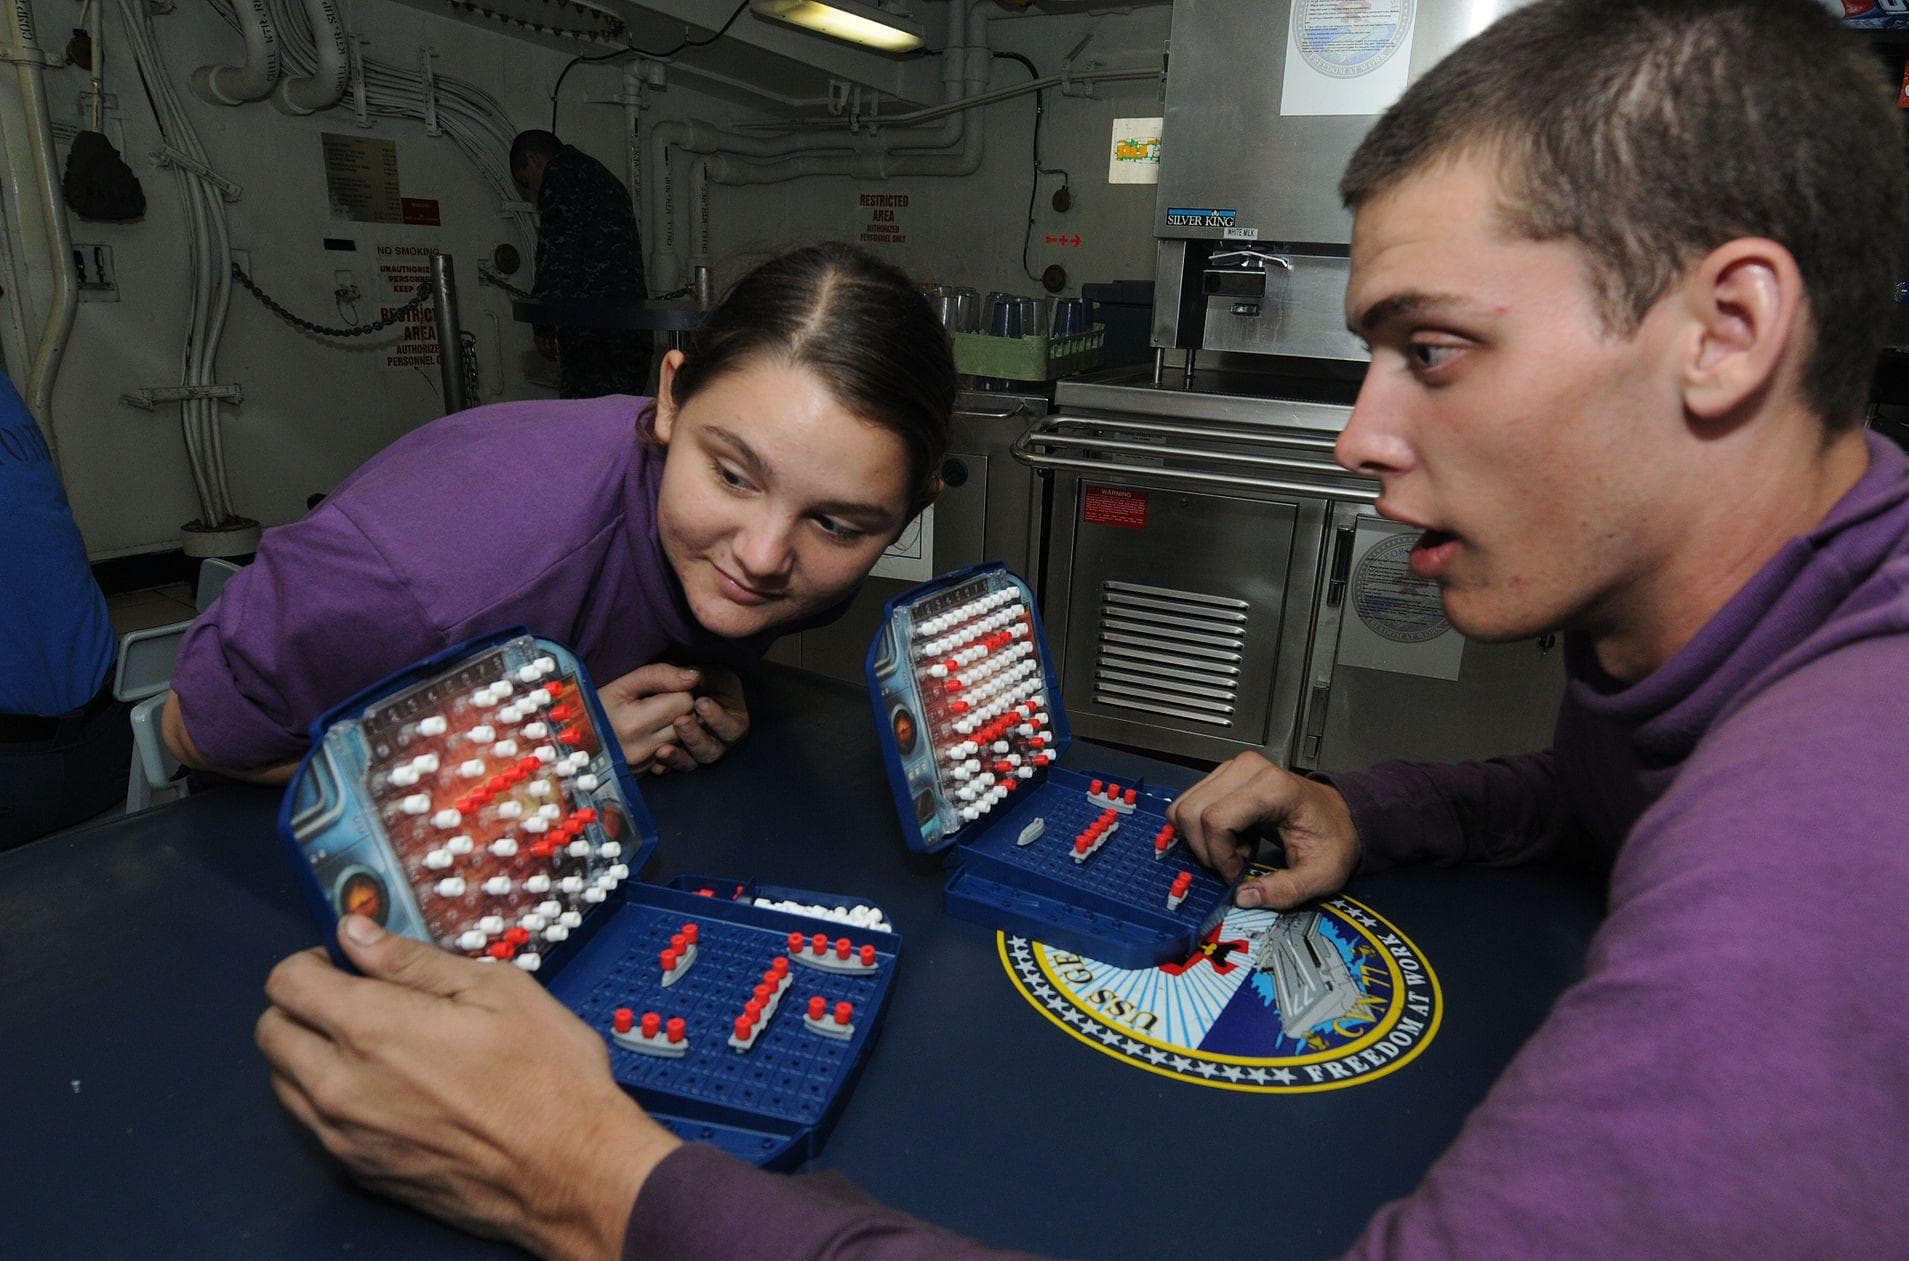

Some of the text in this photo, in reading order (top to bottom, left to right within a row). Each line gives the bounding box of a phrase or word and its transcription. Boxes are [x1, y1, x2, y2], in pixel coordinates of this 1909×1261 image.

[860, 194, 909, 207] RESTRICTED
[872, 210, 895, 222] AREA
[1167, 214, 1235, 227] SILVER KING
[867, 225, 900, 233] AUTHORIZED
[1227, 228, 1255, 237] WHITE MILK
[860, 233, 890, 242] PERSONNEL
[377, 246, 440, 256] NO SMOKING
[393, 285, 414, 293] KEEP
[404, 326, 436, 340] AREA
[387, 355, 435, 366] PERSONNEL
[1101, 487, 1132, 498] WARNING
[1333, 965, 1391, 1038] CVN 77
[1088, 989, 1158, 1031] USS
[1302, 933, 1430, 1083] FREEDOM AT WORK
